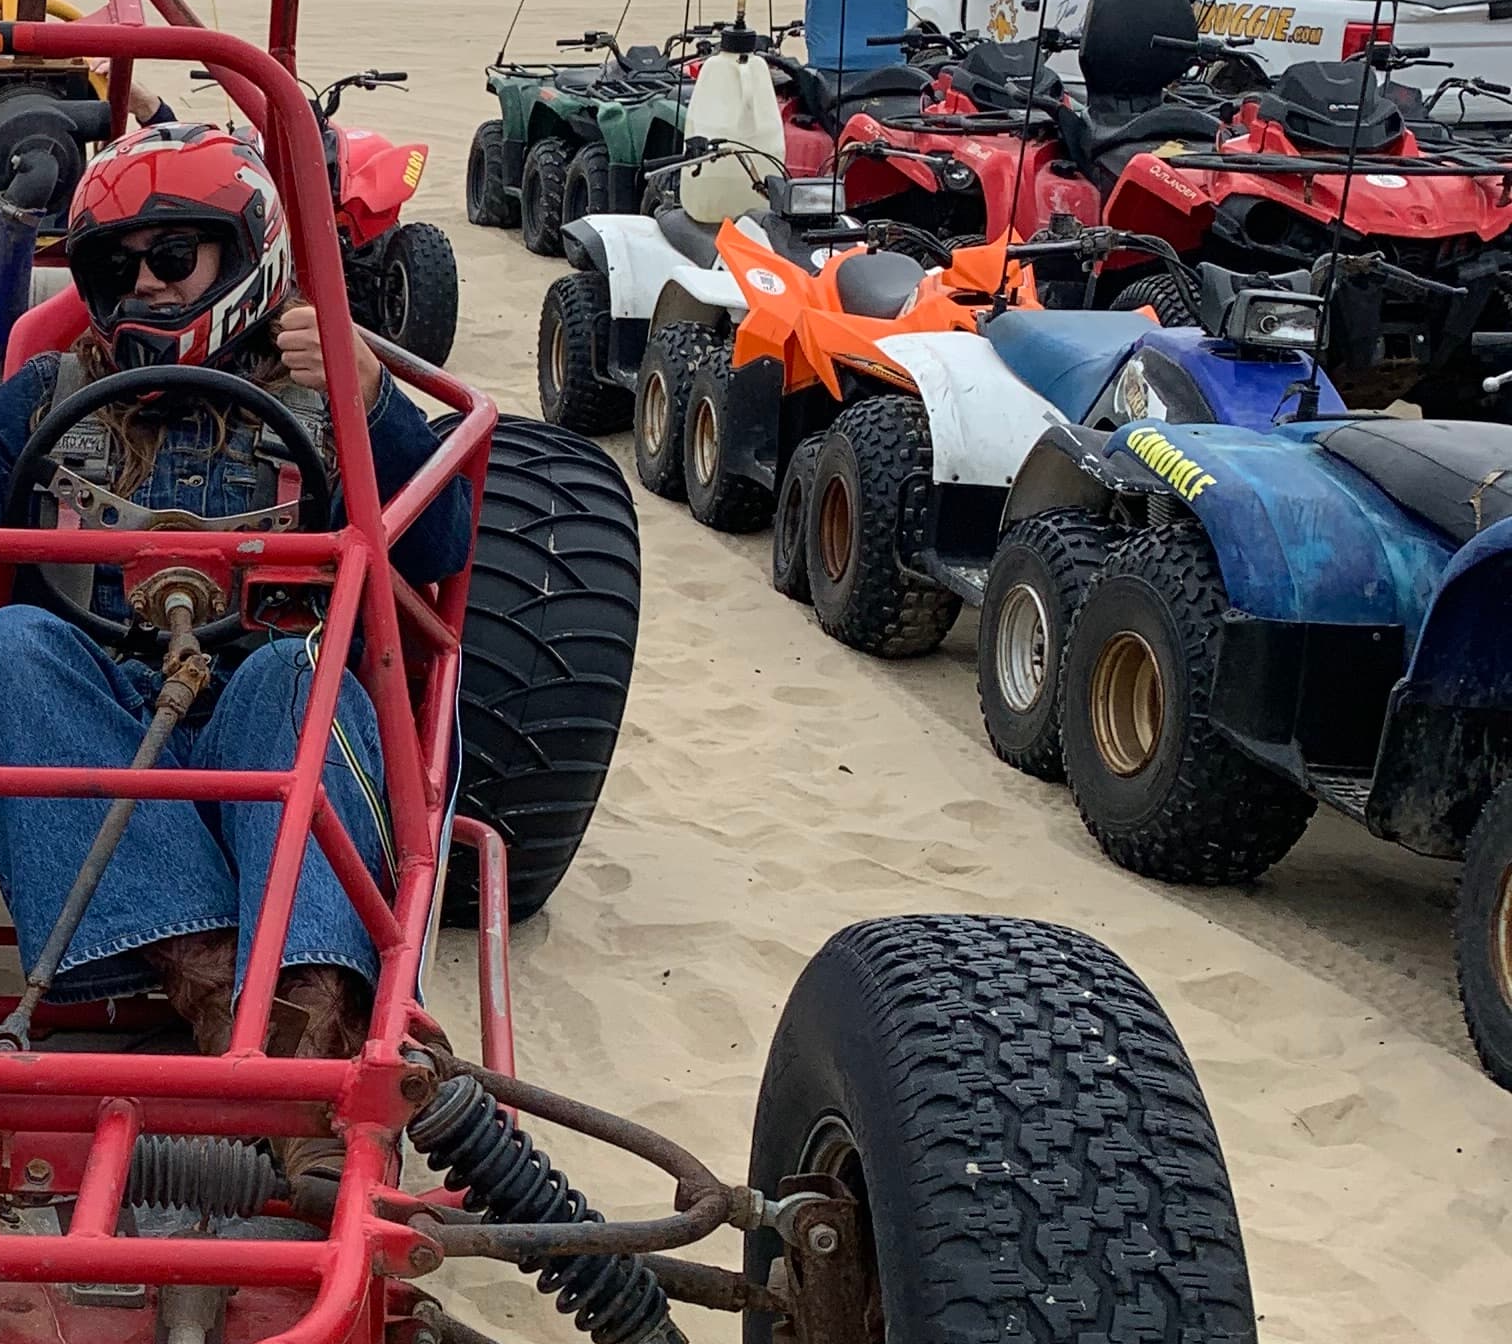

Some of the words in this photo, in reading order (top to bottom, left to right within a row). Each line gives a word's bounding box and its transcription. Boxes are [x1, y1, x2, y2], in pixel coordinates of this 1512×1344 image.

[402, 150, 425, 189] BILBO
[1148, 164, 1198, 201] OUTLANDER
[1126, 426, 1218, 502] GANDALF
